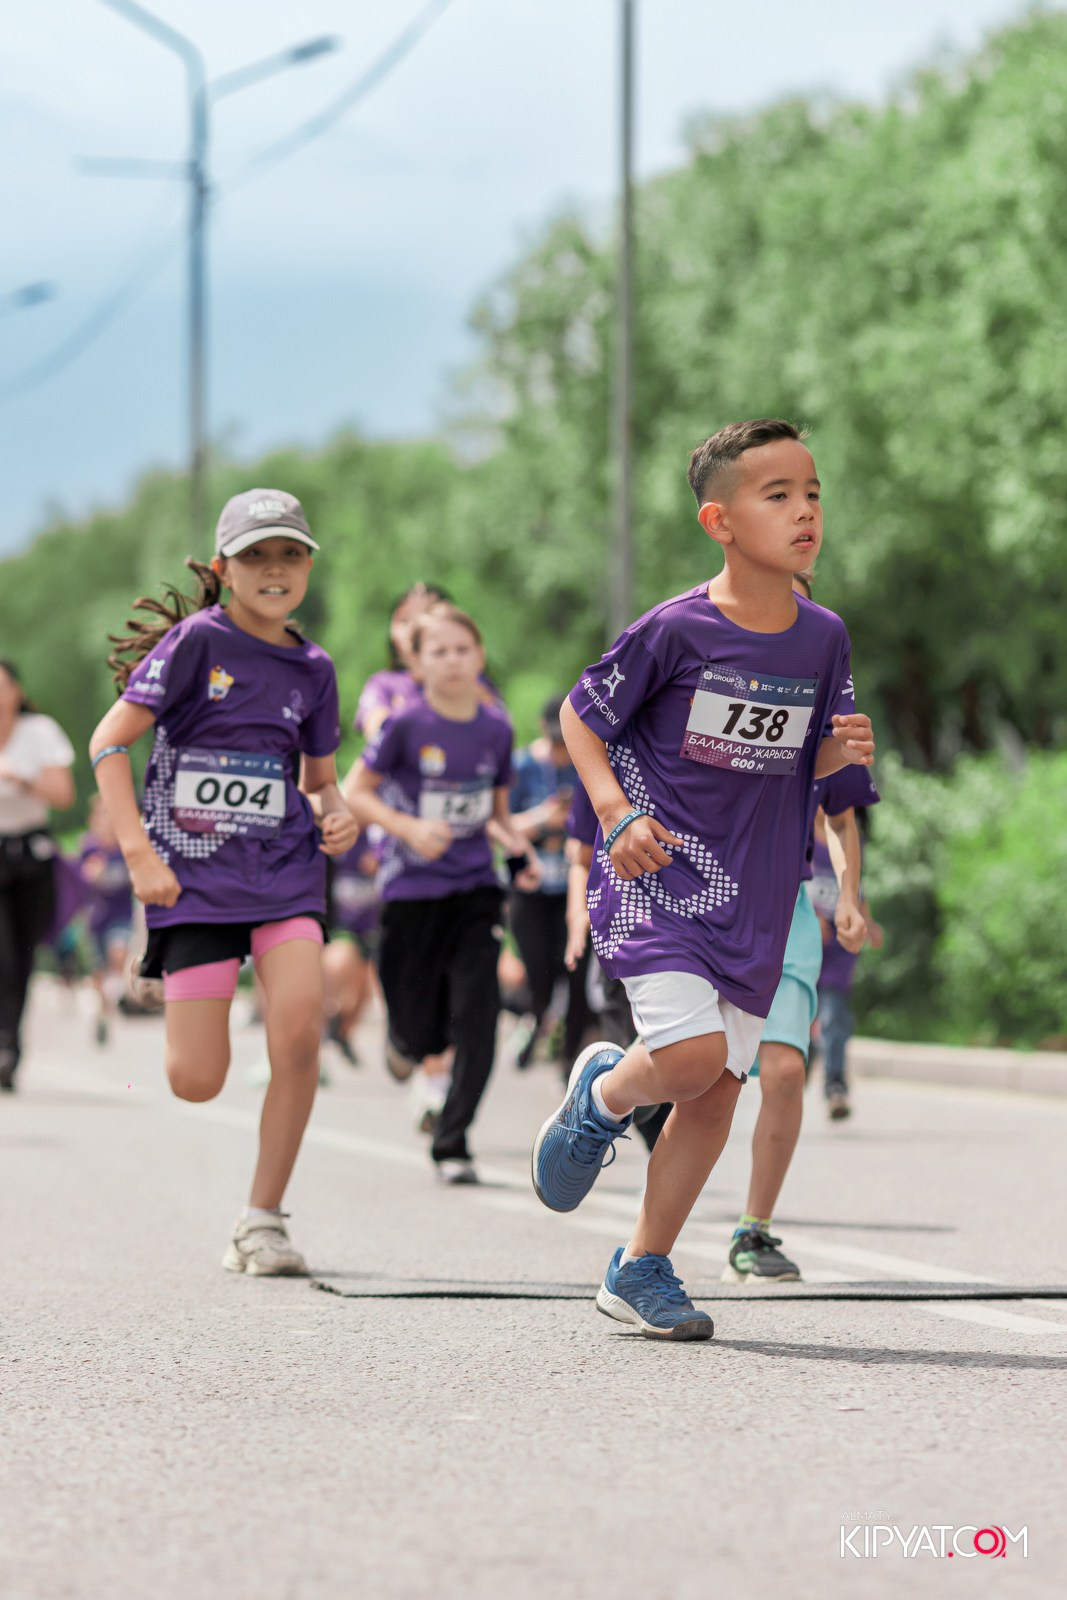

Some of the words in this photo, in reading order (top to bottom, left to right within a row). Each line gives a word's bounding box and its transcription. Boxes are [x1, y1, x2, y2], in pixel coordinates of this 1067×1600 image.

[713, 674, 736, 684] GROUP
[722, 703, 789, 742] 138
[687, 734, 751, 756] БАЛАЛАР
[752, 748, 796, 760] ЖАРЫСЫ
[730, 757, 756, 770] 600
[196, 777, 272, 810] 004
